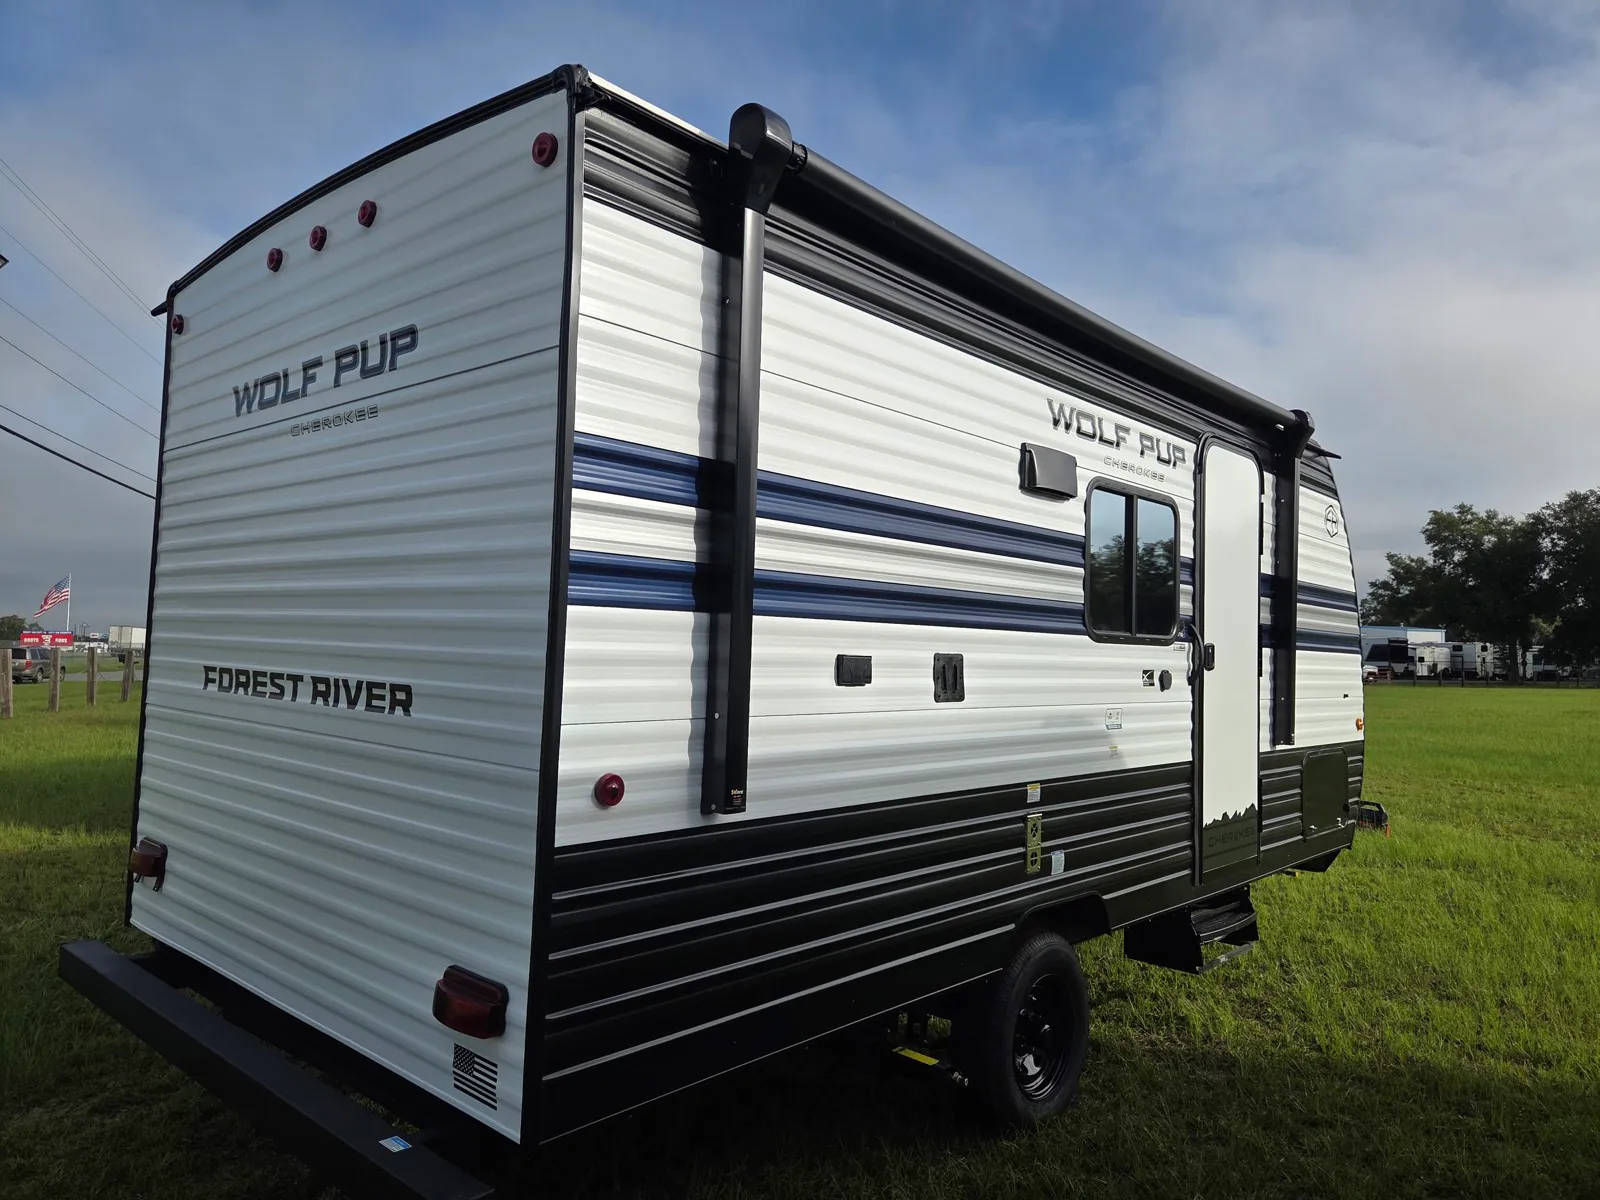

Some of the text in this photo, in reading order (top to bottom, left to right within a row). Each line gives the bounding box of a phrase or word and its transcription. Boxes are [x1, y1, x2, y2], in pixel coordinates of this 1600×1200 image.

[232, 323, 419, 418] WOLF PUP
[290, 403, 379, 437] CHEROKEE
[1047, 398, 1186, 470] WOLF PUP
[1103, 455, 1165, 483] CHEROKEE
[202, 665, 413, 718] FOREST RIVER
